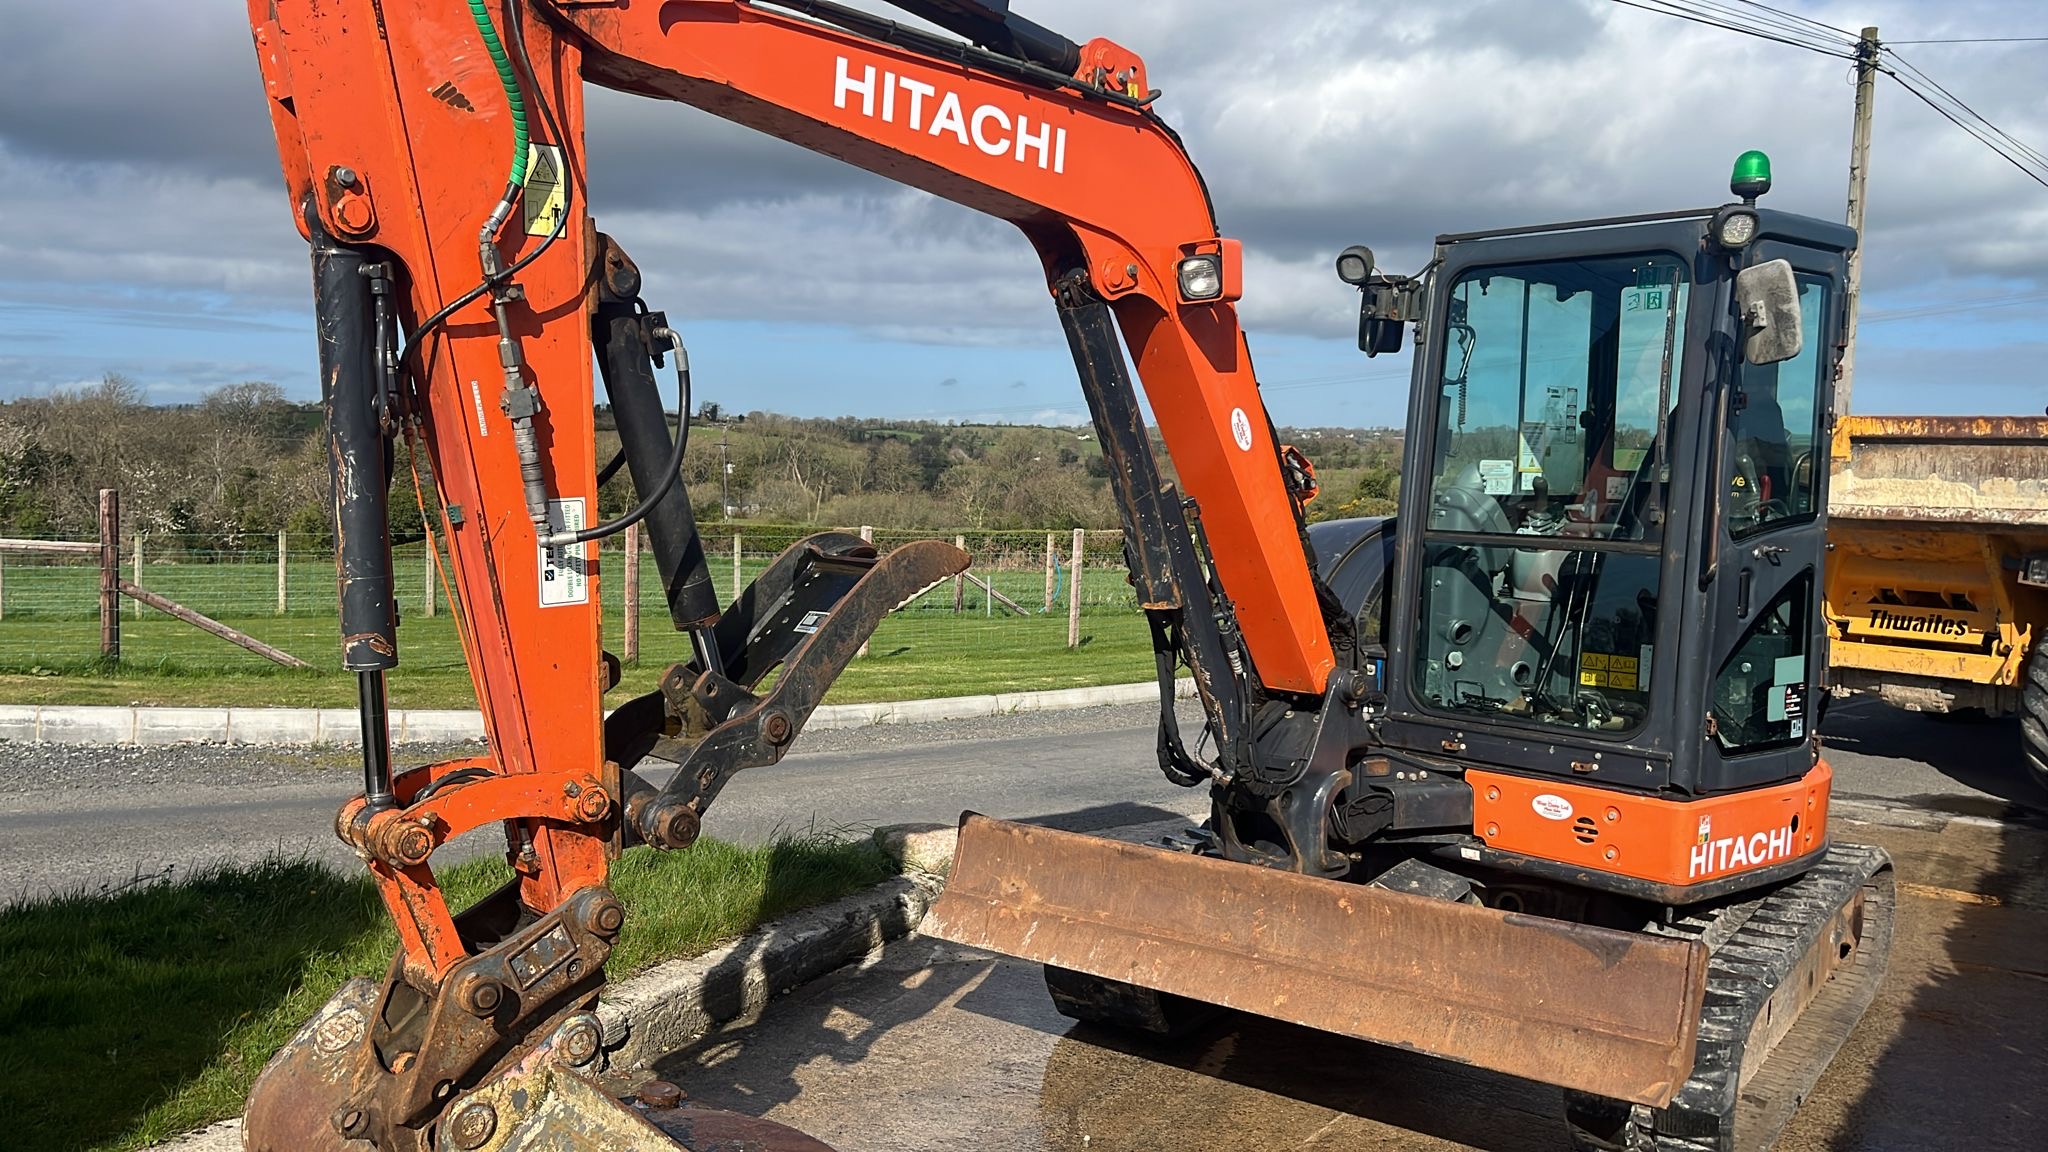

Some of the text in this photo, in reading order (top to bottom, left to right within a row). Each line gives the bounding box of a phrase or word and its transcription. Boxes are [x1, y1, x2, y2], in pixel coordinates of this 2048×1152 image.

[834, 56, 1066, 174] HITACHI
[576, 578, 582, 586] NO
[1870, 609, 1968, 636] Thwaites
[1689, 825, 1793, 878] HITACHI
